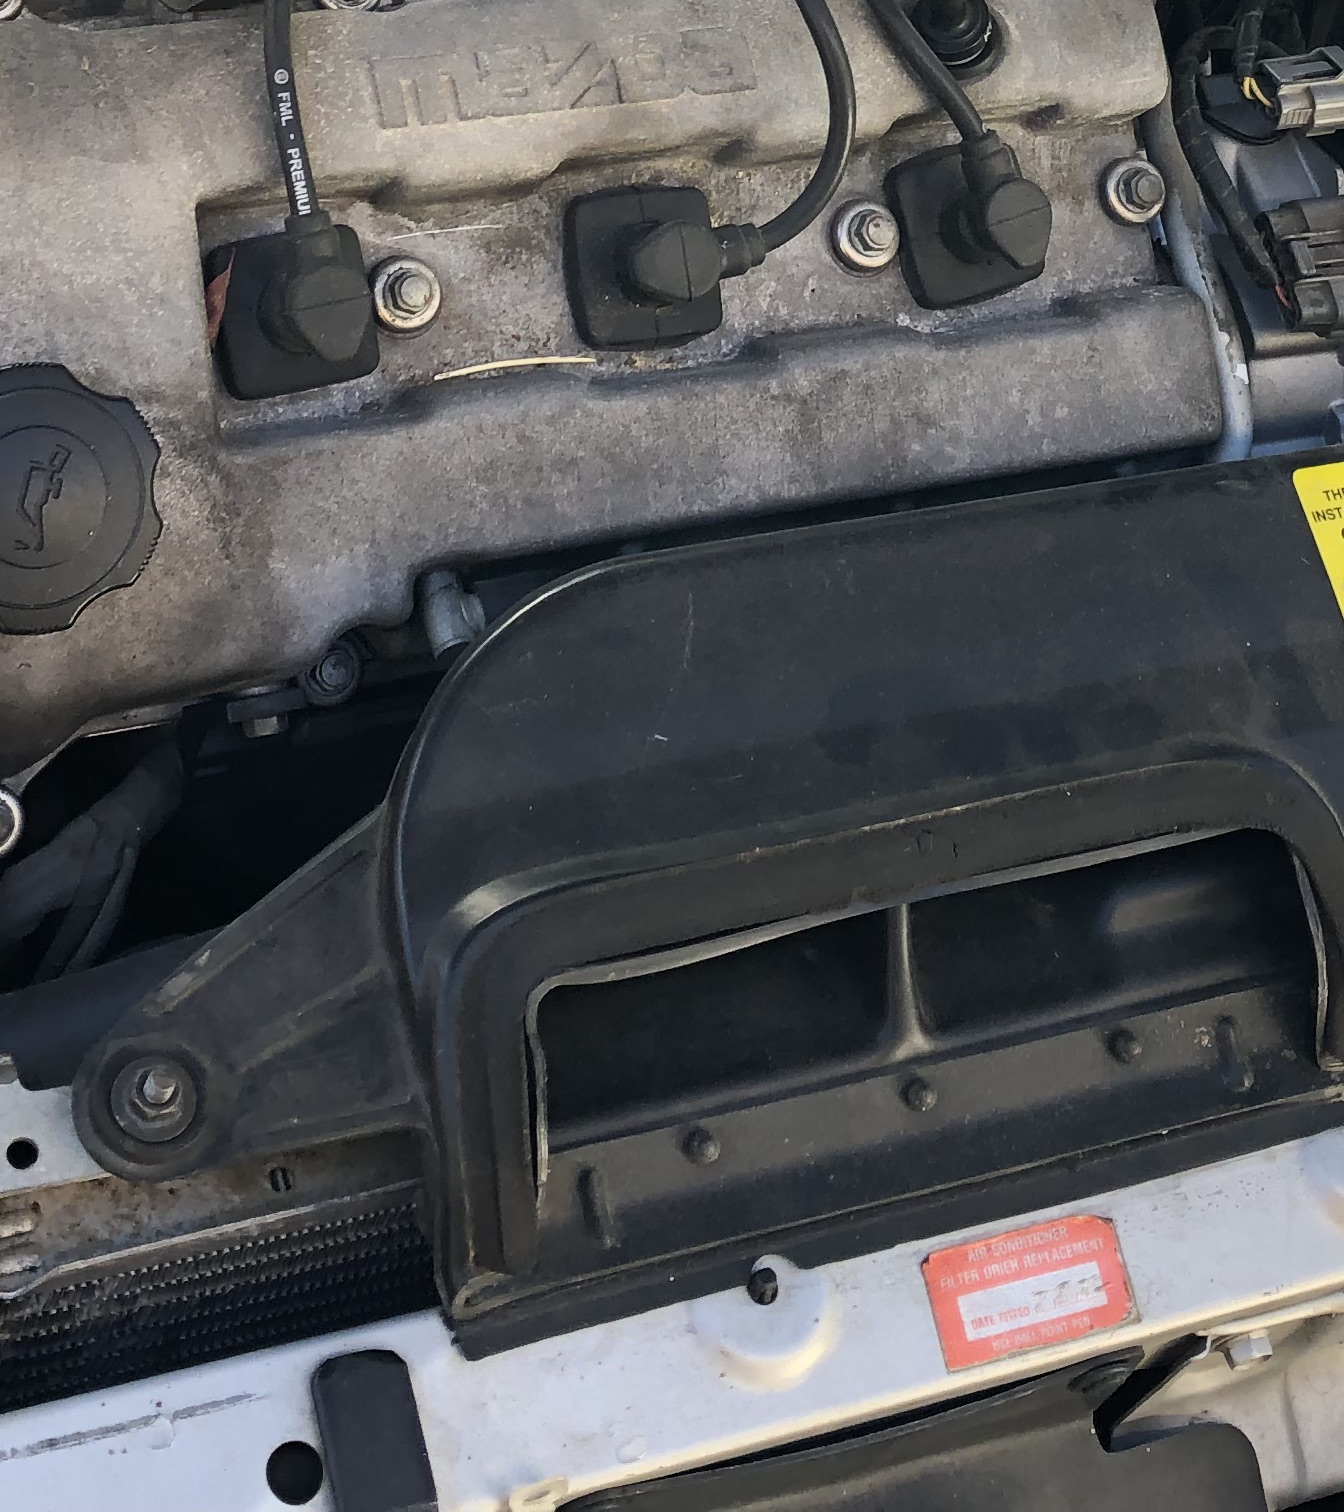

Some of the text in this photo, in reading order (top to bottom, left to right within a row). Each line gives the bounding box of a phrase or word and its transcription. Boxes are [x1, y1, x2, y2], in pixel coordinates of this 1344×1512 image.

[276, 90, 290, 128] FML
[939, 1238, 1104, 1291] FILTER DRIER REPLACEMENT
[967, 1248, 988, 1263] AIR
[971, 1317, 995, 1331] DATE
